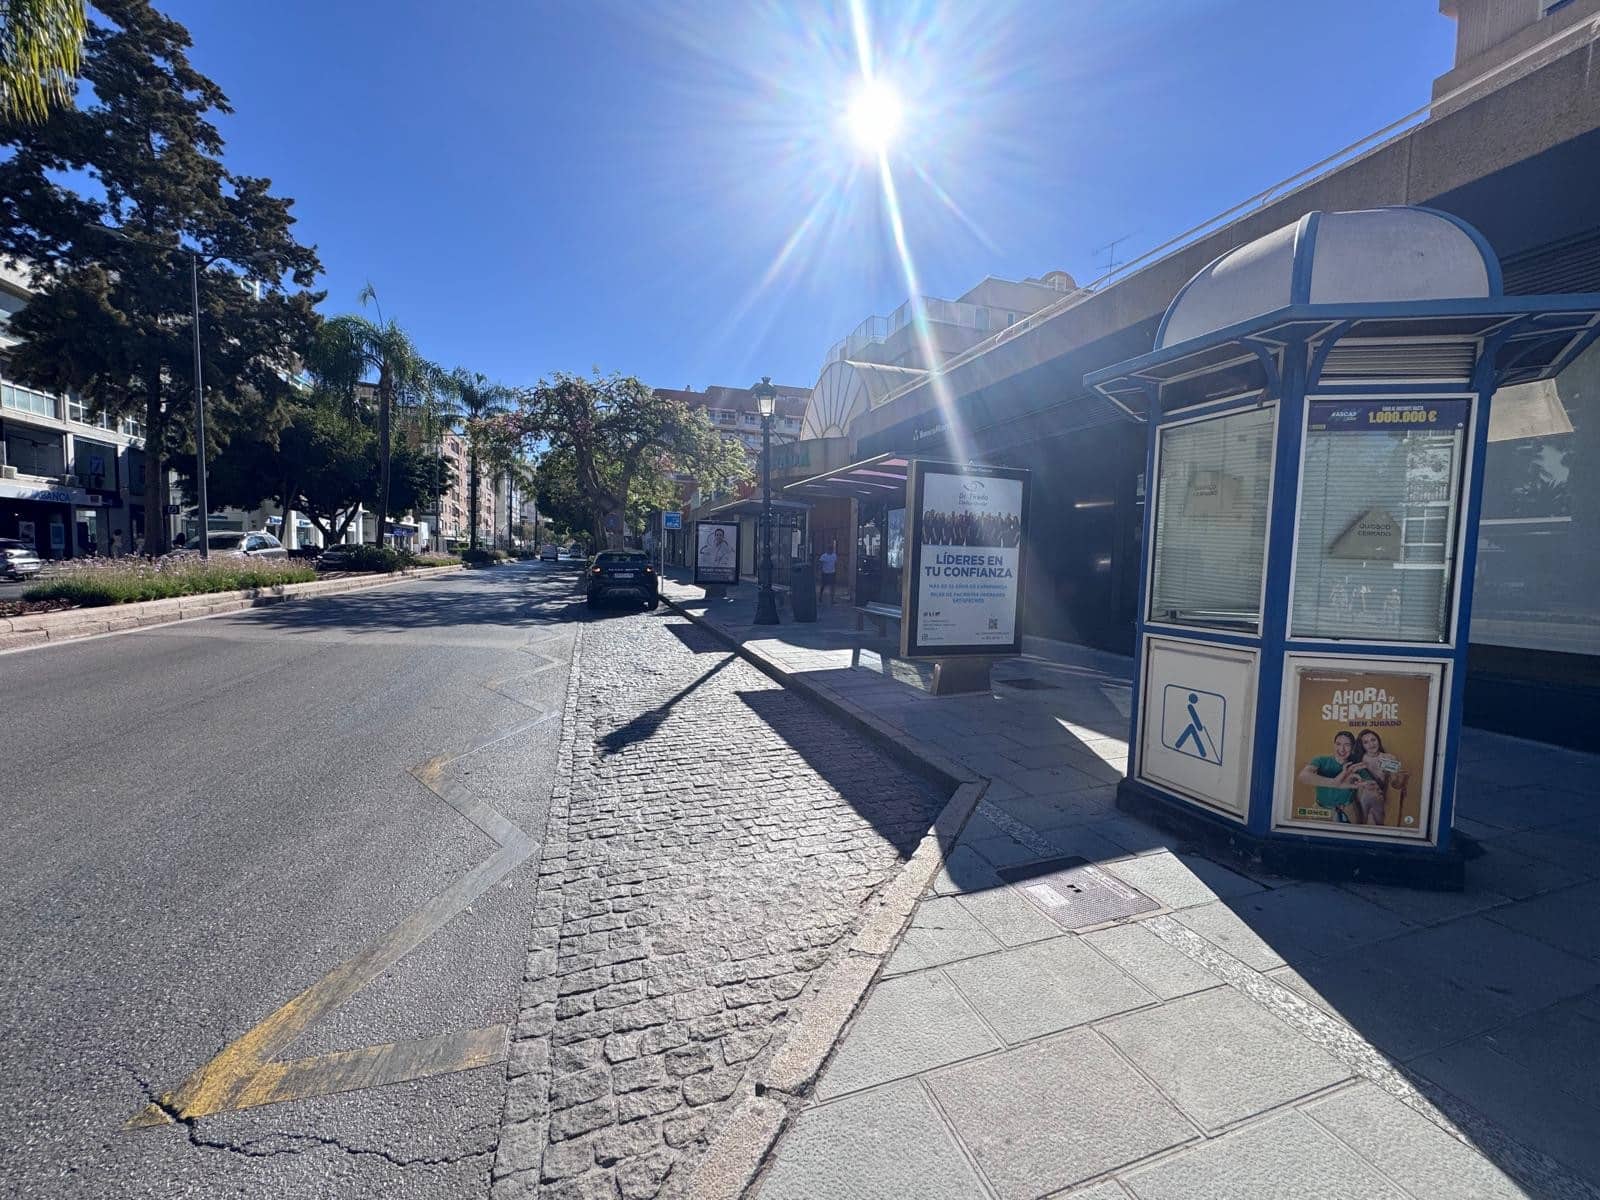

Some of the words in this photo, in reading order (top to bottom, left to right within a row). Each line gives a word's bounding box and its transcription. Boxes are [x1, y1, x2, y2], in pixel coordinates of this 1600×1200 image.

[1368, 411, 1426, 423] 1.000.000
[1428, 410, 1437, 422] €
[936, 552, 985, 566] LÍDERES
[987, 555, 1003, 566] EN
[925, 566, 940, 577] TU
[944, 566, 1013, 579] CONFIANZA
[1332, 687, 1387, 705] AHORA
[1321, 701, 1399, 722] SIEMPRE
[1307, 809, 1330, 817] ONCE
